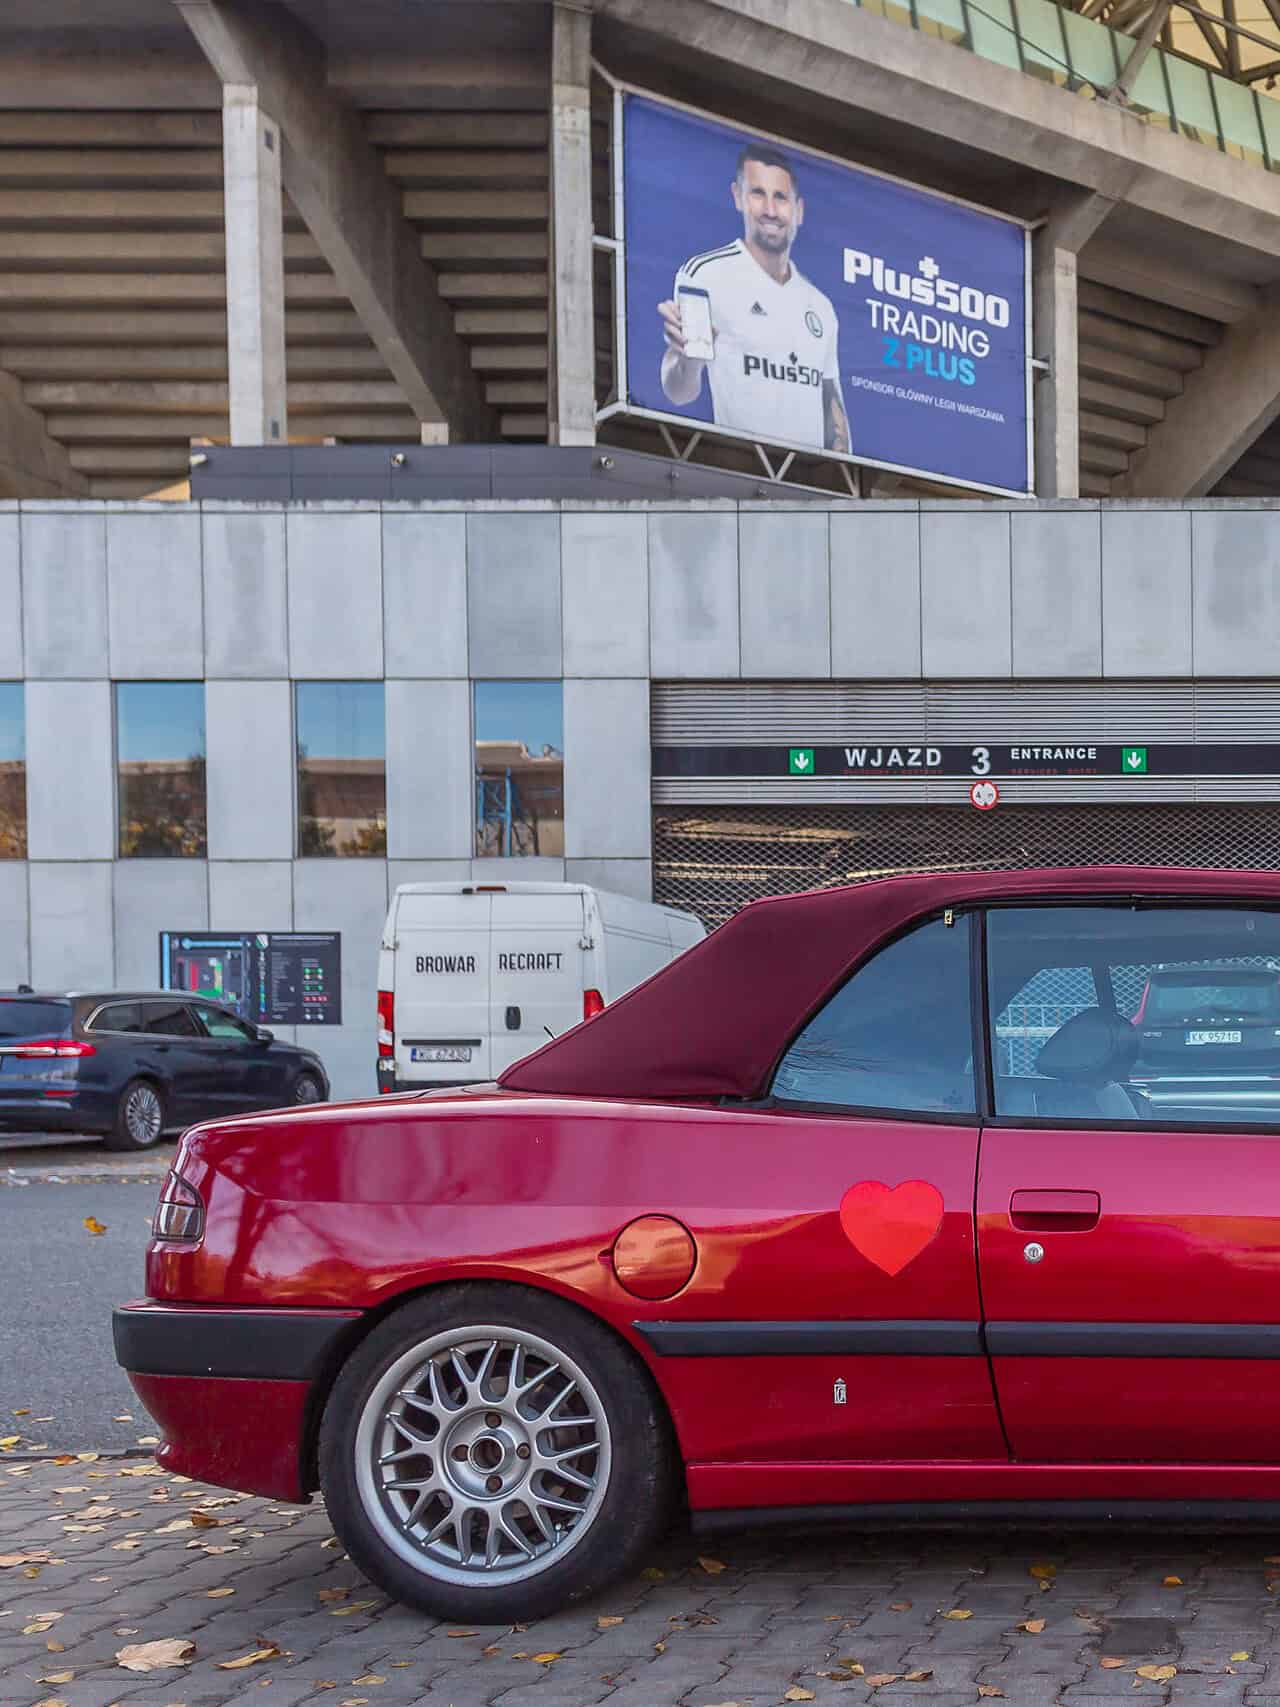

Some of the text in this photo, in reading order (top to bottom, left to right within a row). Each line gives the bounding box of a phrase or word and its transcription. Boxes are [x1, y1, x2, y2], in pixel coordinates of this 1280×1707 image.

[844, 248, 1009, 328] Plus500
[866, 299, 990, 357] TRADING
[743, 352, 824, 387] Plus50
[882, 337, 976, 385] Z PLUS
[851, 376, 895, 396] SPONSOR
[844, 746, 1097, 775] WJAZD 3 ENTRANCE
[416, 952, 563, 973] BROWAR RECRAFT
